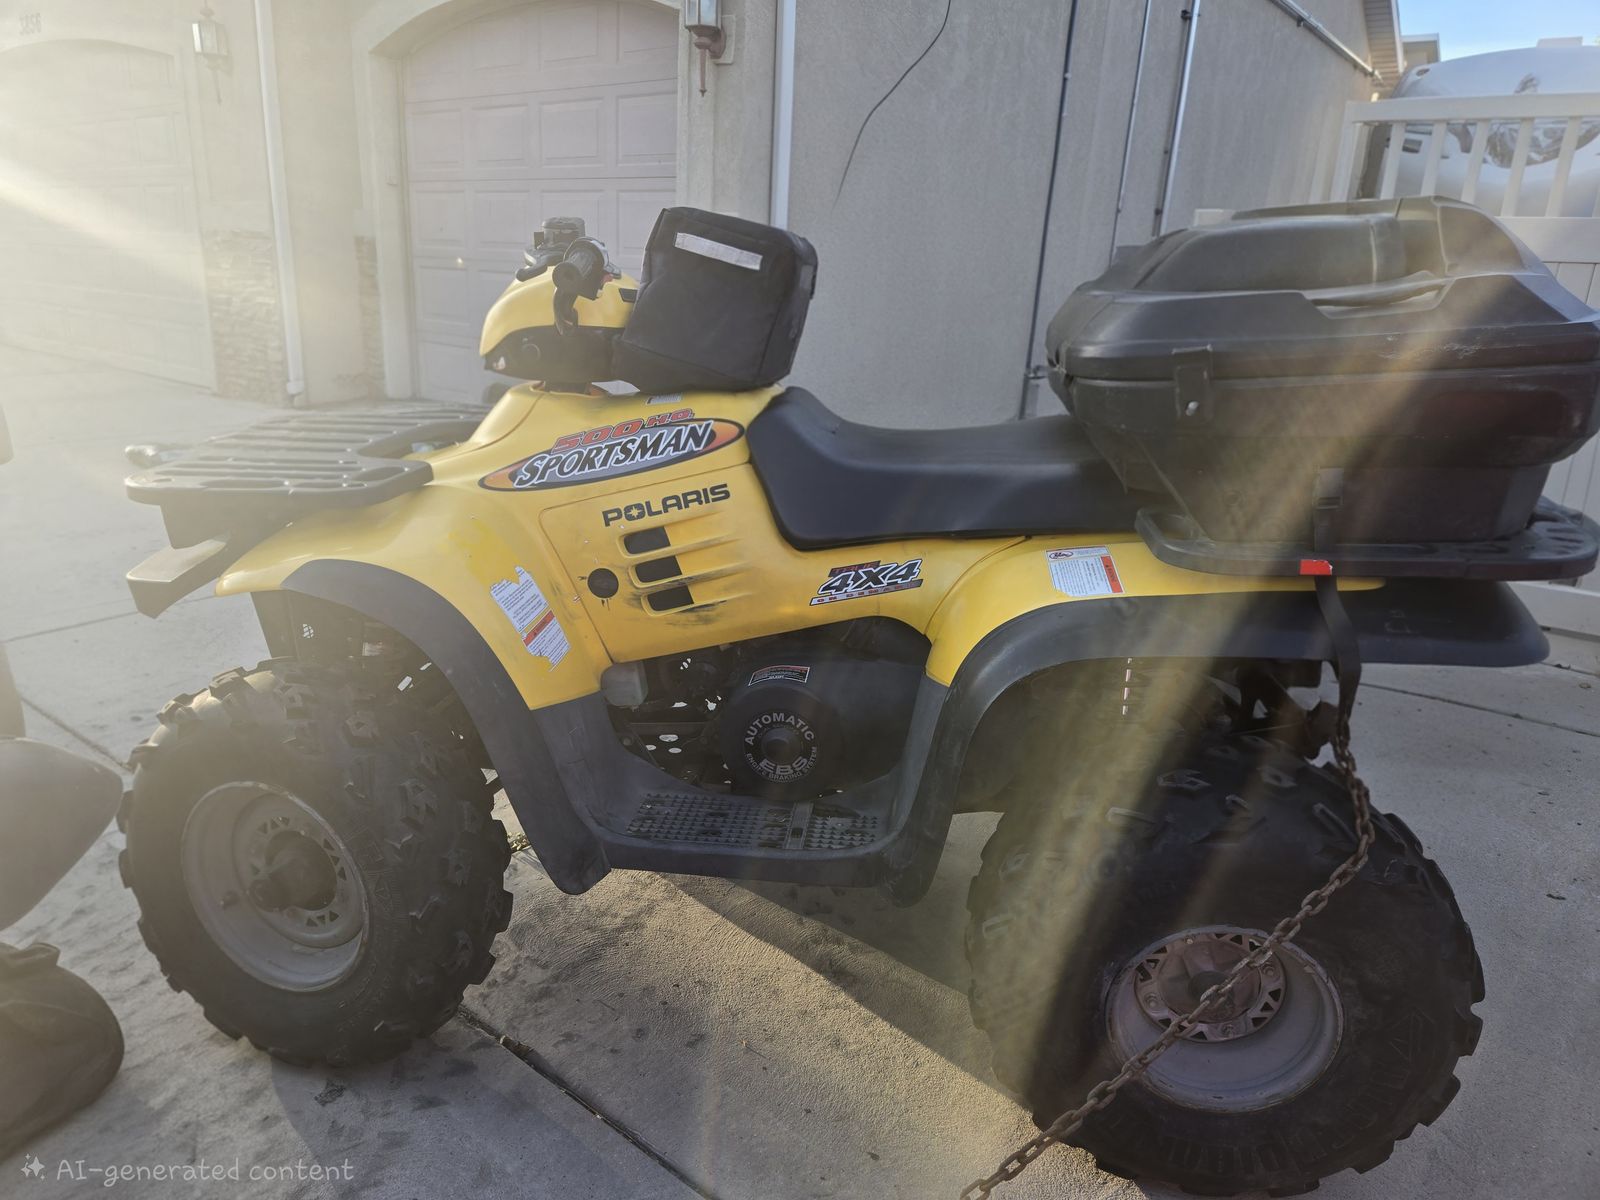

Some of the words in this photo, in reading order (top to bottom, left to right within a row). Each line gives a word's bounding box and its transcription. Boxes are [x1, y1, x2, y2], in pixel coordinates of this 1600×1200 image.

[552, 418, 644, 452] 500
[513, 420, 714, 488] SPORTSMAN
[602, 483, 731, 527] POLARIS
[818, 559, 922, 595] 4X4
[745, 712, 815, 745] AUTOMATIC
[760, 756, 808, 775] EBS
